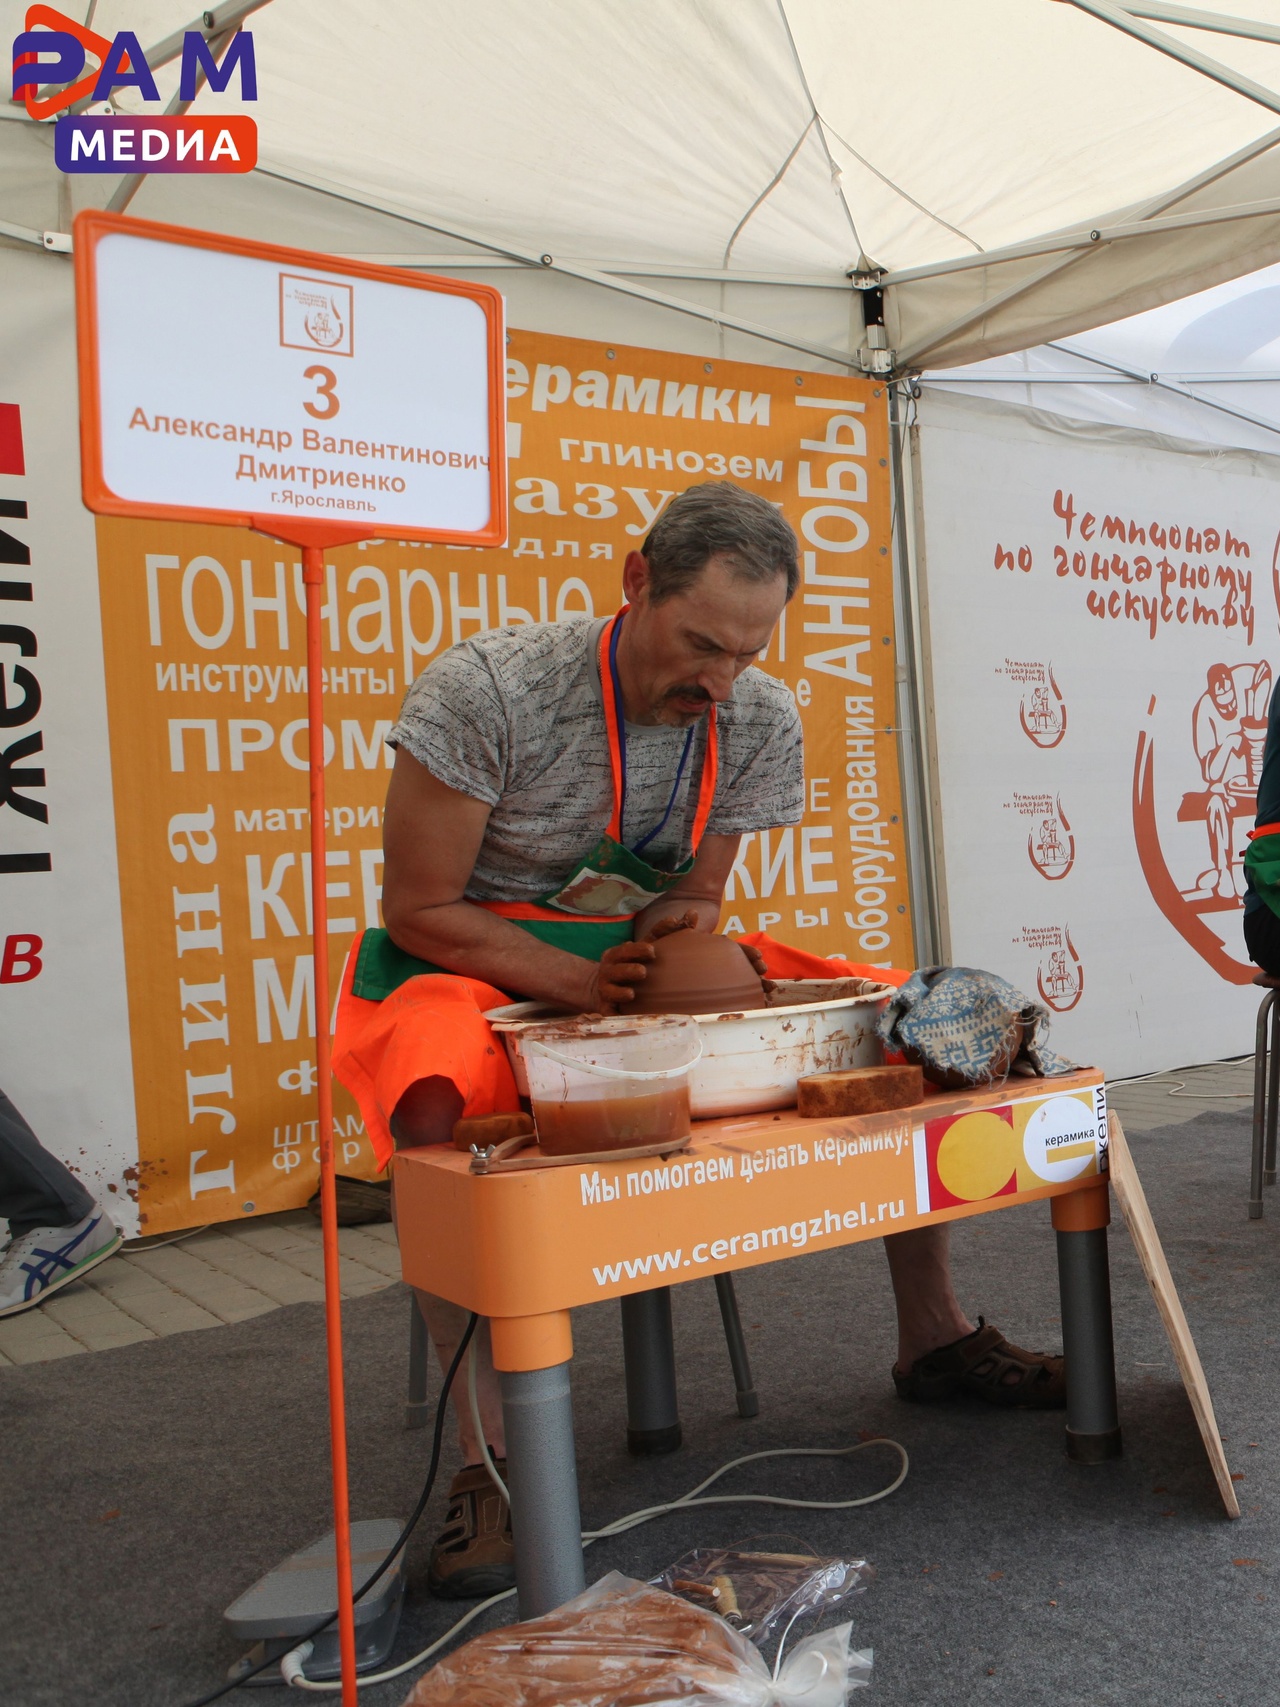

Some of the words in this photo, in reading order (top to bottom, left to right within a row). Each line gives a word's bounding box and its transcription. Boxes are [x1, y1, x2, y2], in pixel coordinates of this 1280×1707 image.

[302, 365, 341, 420] 3
[507, 358, 771, 426] ерамики
[128, 407, 293, 448] Александр
[302, 428, 491, 472] Валентинович
[560, 438, 783, 482] глинозем
[236, 454, 406, 493] Дмитриенко
[270, 489, 377, 512] г.Ярославль
[513, 537, 613, 560] для
[795, 395, 873, 687] АНГОБЫ
[1053, 489, 1251, 559] Чемпионат
[994, 543, 1033, 573] по
[1055, 544, 1252, 608] гончарному
[1086, 589, 1255, 646] искусству
[844, 695, 896, 951] оборудования
[168, 804, 237, 1200] глина
[580, 1171, 620, 1206] Мы
[627, 1154, 734, 1198] помогаем
[740, 1142, 808, 1183] делать
[814, 1125, 910, 1166] керамику!
[1045, 1128, 1095, 1147] керамика
[592, 1199, 906, 1286] www.ceramgzhel.ru
